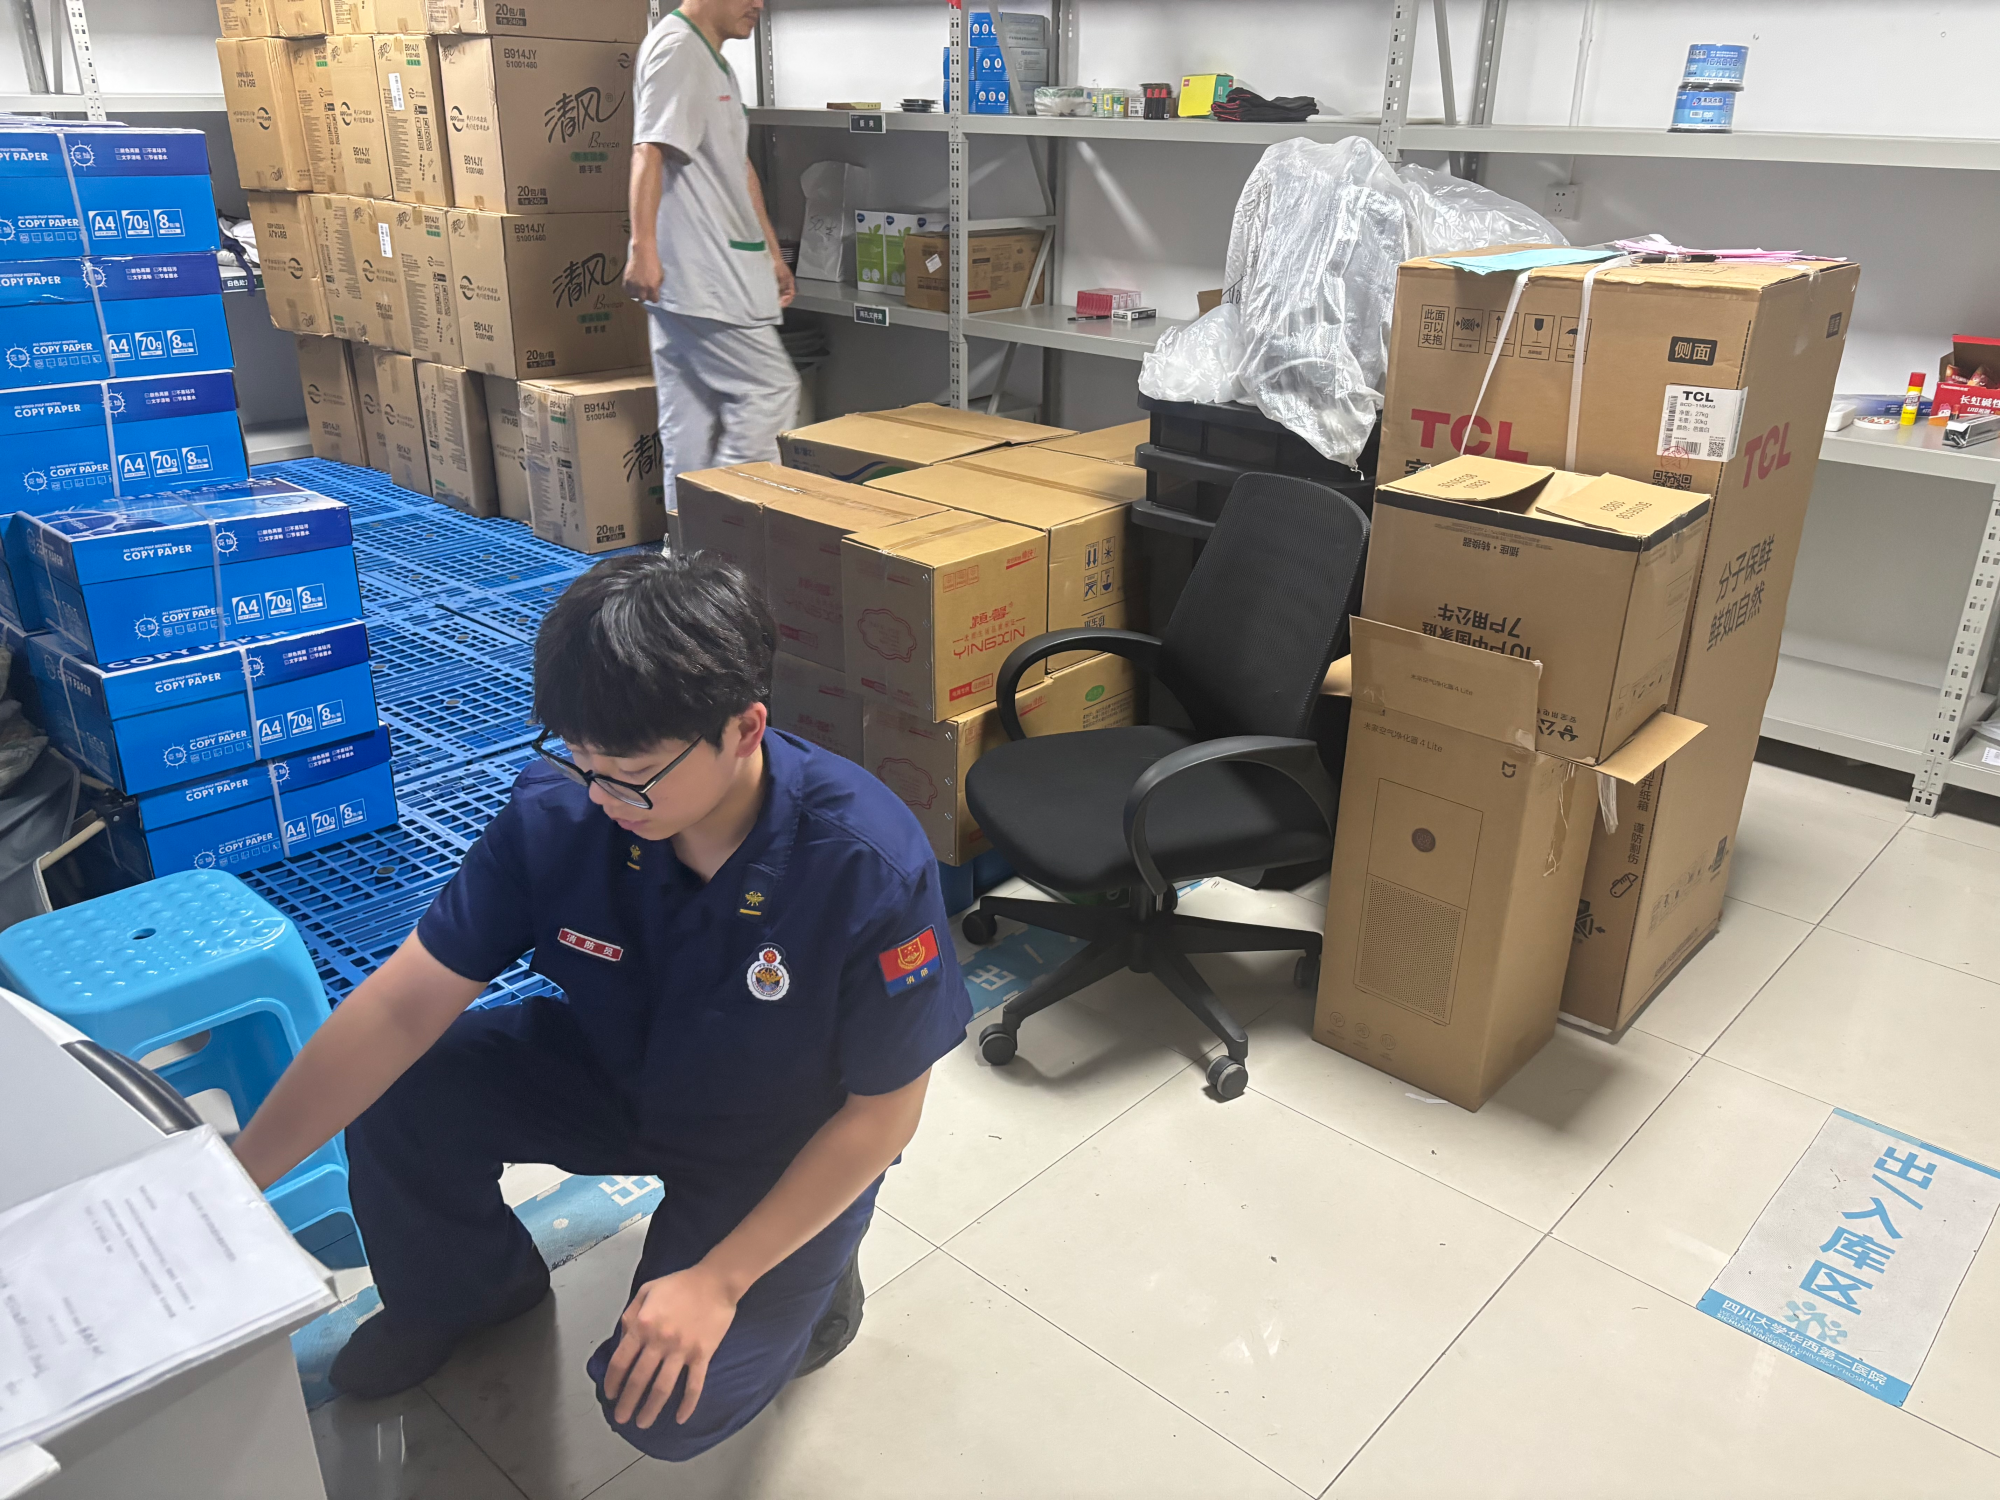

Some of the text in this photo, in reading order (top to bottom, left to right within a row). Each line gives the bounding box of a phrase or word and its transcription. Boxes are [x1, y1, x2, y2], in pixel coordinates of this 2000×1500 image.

[504, 48, 537, 60] B914JY
[544, 86, 626, 143] 清风
[14, 152, 49, 161] PAPER
[18, 218, 79, 228] COPY PAPER
[94, 216, 116, 230] A4
[125, 215, 149, 230] 70g
[514, 223, 545, 234] B914JY
[27, 276, 61, 286] PAPER
[552, 252, 626, 309] 清风
[1424, 309, 1446, 322] 此面
[1422, 321, 1444, 334] 可以
[109, 339, 129, 352] A4
[138, 337, 162, 351] 70g
[1421, 333, 1443, 346] 夹抱
[33, 342, 93, 355] COPY PAPER
[1674, 341, 1712, 362] 侧面
[1682, 391, 1714, 403] TCL
[14, 408, 44, 418] COPY
[47, 404, 81, 415] PAPER
[584, 401, 616, 413] B914JY
[1411, 408, 1529, 464] TCL
[153, 455, 177, 469] 70g
[1743, 422, 1791, 489] TCL
[50, 467, 77, 478] COPY
[79, 463, 109, 474] PAPER
[124, 458, 145, 472] A4
[123, 544, 192, 562] COPY PAPER
[1716, 534, 1775, 604] 分子保鲜
[238, 599, 259, 616] A4
[268, 595, 292, 610] 70g
[162, 612, 189, 623] COPY
[1437, 603, 1523, 638] 7户用公牛
[1706, 580, 1765, 651] 鲜如自然
[953, 625, 1025, 659] YINGXIN
[107, 648, 195, 669] COPY
[155, 672, 221, 693] COPY PAPER
[1410, 673, 1454, 691] 米家空气净化器
[1460, 687, 1473, 696] Lite
[261, 721, 282, 737] A4
[291, 714, 312, 730] 70g
[190, 730, 247, 750] COPY PAPER
[1363, 722, 1418, 745] 米家空气净化器
[1427, 740, 1443, 753] Lite
[186, 788, 215, 802] COPY
[217, 779, 249, 793] PAPER
[314, 814, 335, 829] 70g
[285, 822, 305, 838] A4
[218, 841, 244, 854] COPY
[246, 833, 273, 846] PAPER
[1627, 822, 1645, 865] 谨防割伤
[566, 933, 614, 957] 消防员
[906, 968, 928, 984] 消防
[1798, 1145, 1937, 1316] 出/入库区
[1717, 1313, 1800, 1356] SICHUAN UNIVERSITY
[1722, 1300, 1887, 1385] 四川大学华西第二医院
[1720, 1310, 1880, 1391] WEST CHINA SECOND UNIVERSITY HOSPITAL
